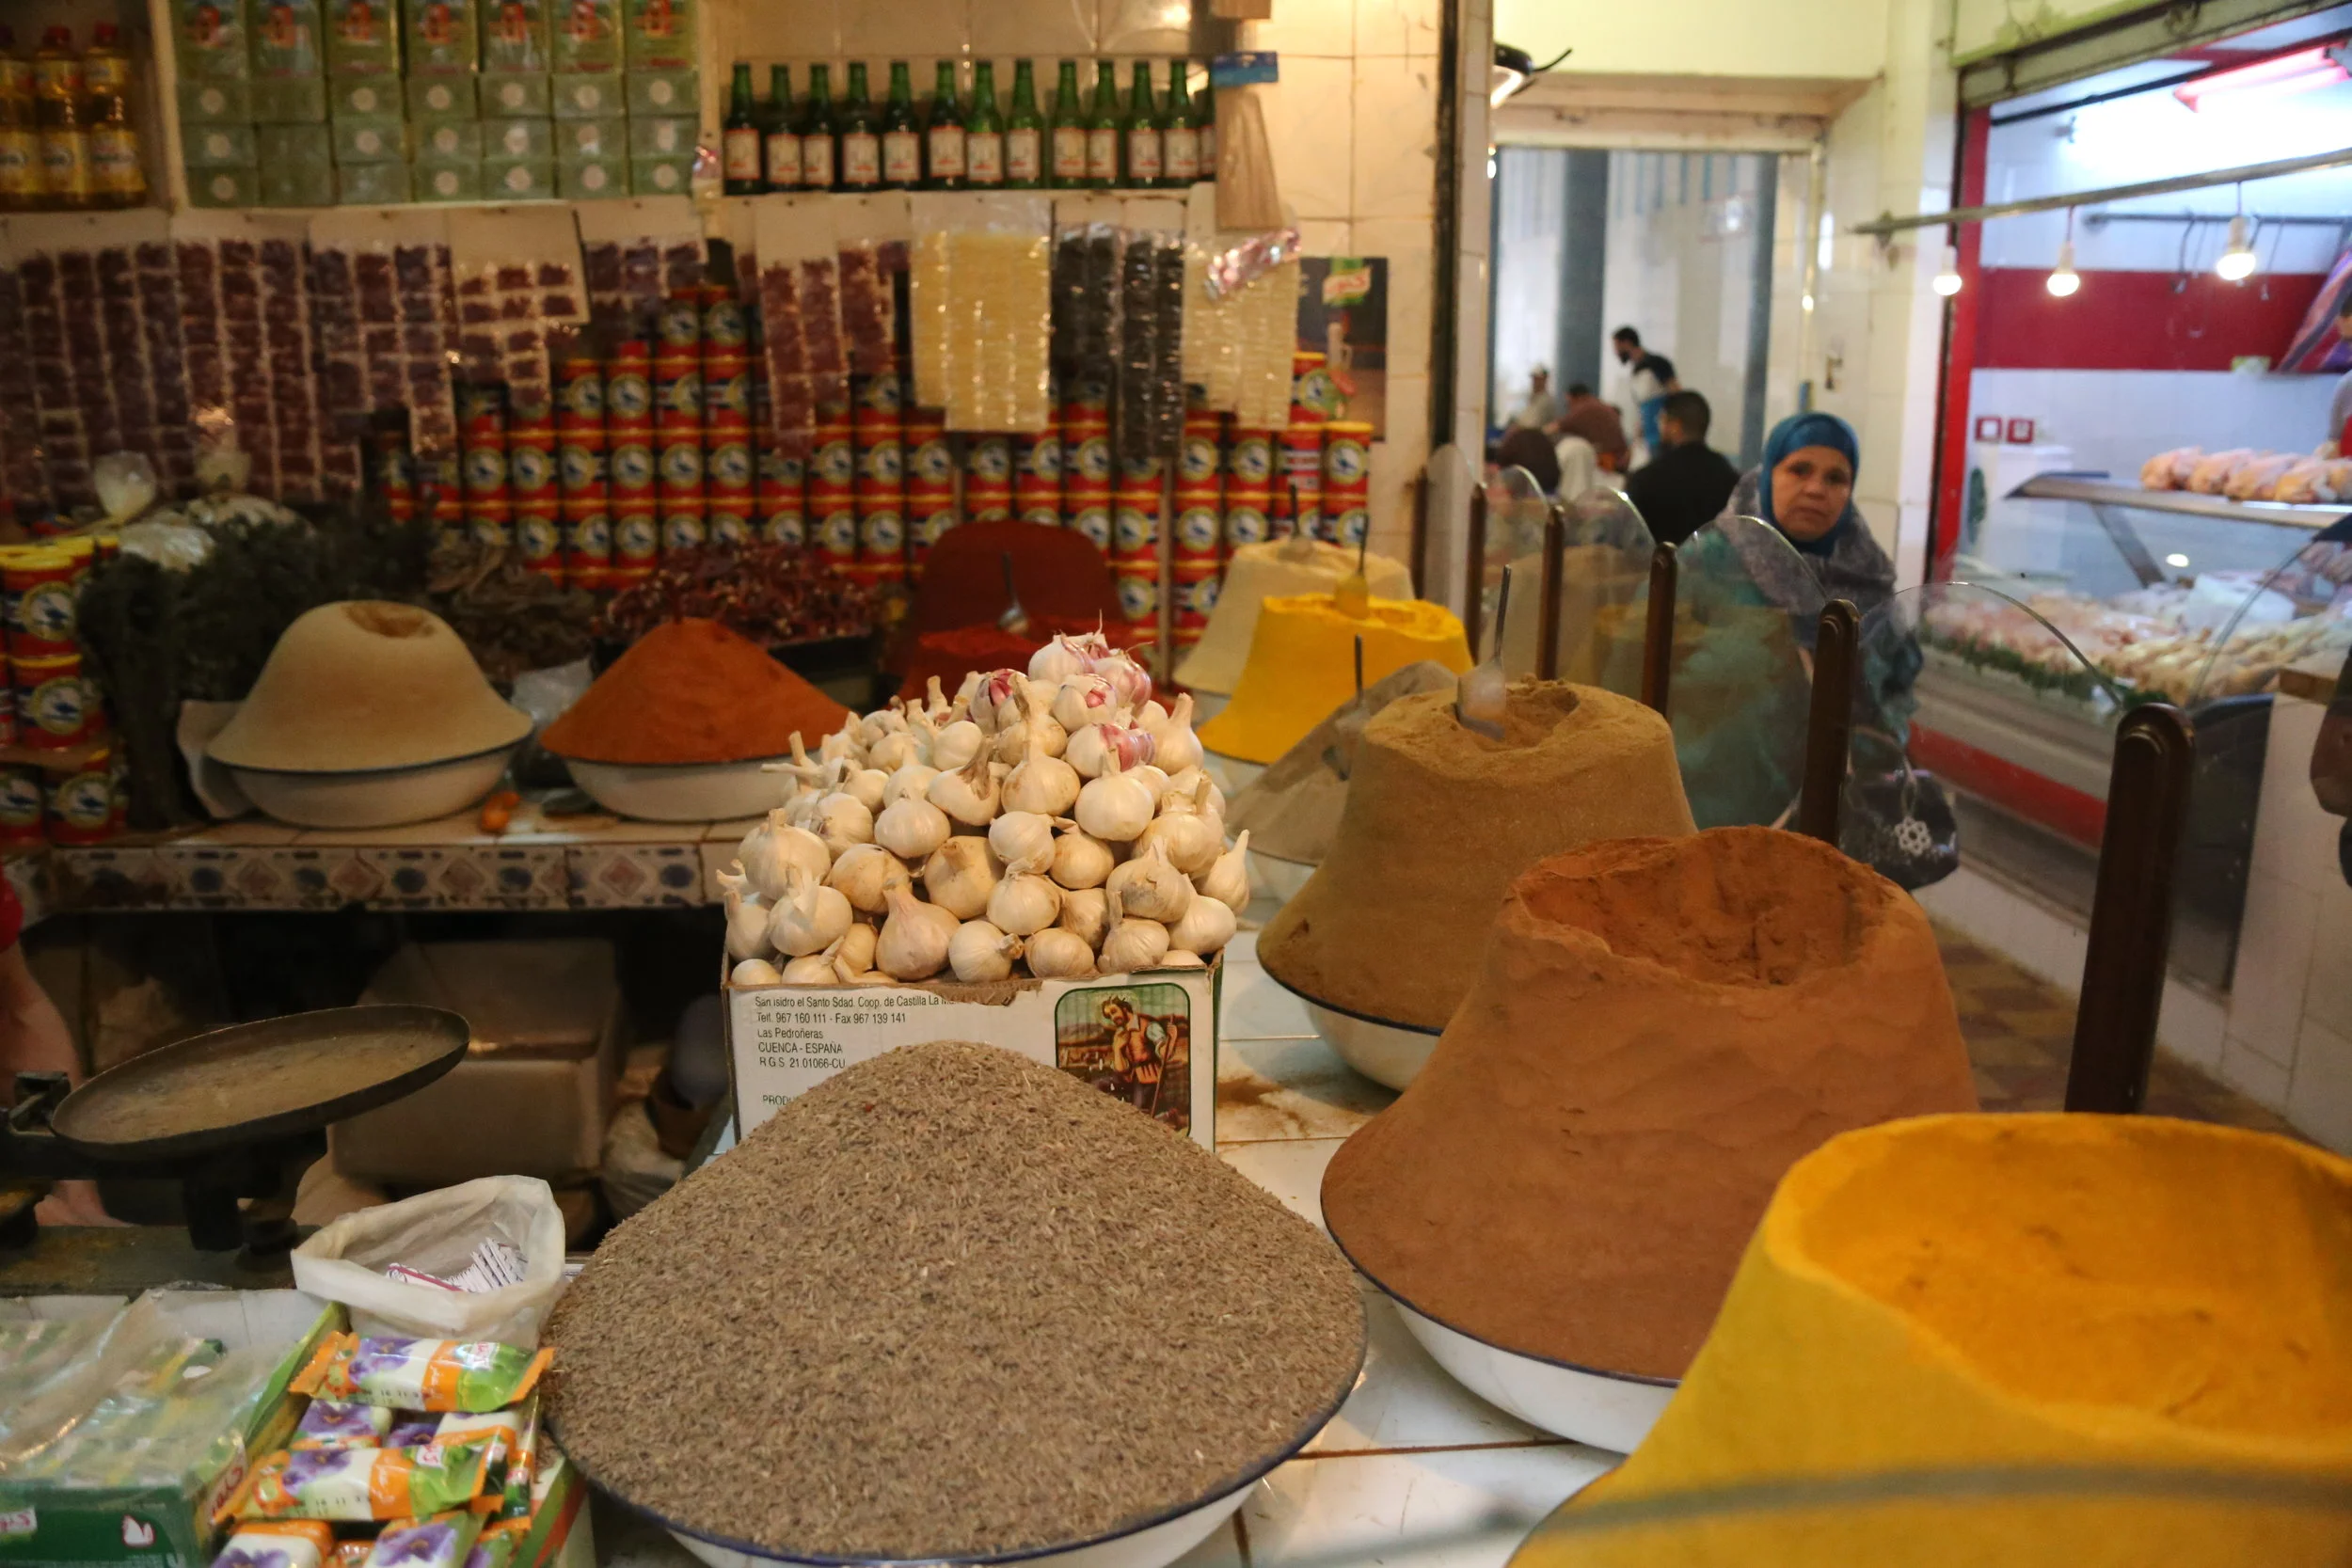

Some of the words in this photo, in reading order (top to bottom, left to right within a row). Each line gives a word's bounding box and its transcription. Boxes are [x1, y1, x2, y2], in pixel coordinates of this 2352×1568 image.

[755, 996, 771, 1007] San
[797, 996, 804, 1007] el
[806, 996, 831, 1007] Santo
[857, 997, 882, 1009] Coop.
[883, 996, 895, 1007] de
[896, 995, 927, 1006] Castilla
[929, 995, 939, 1006] La
[775, 1012, 791, 1023] 967
[794, 1012, 810, 1023] 160
[814, 1013, 827, 1023] 111
[835, 1013, 851, 1023] Fax
[853, 1013, 869, 1023] 967
[873, 1013, 888, 1023] 139
[891, 1012, 906, 1023] 141
[757, 1027, 772, 1038] Las
[774, 1027, 824, 1038] Pedroñeras
[758, 1041, 798, 1053] CUENCA
[805, 1040, 843, 1053] ESPAÑA
